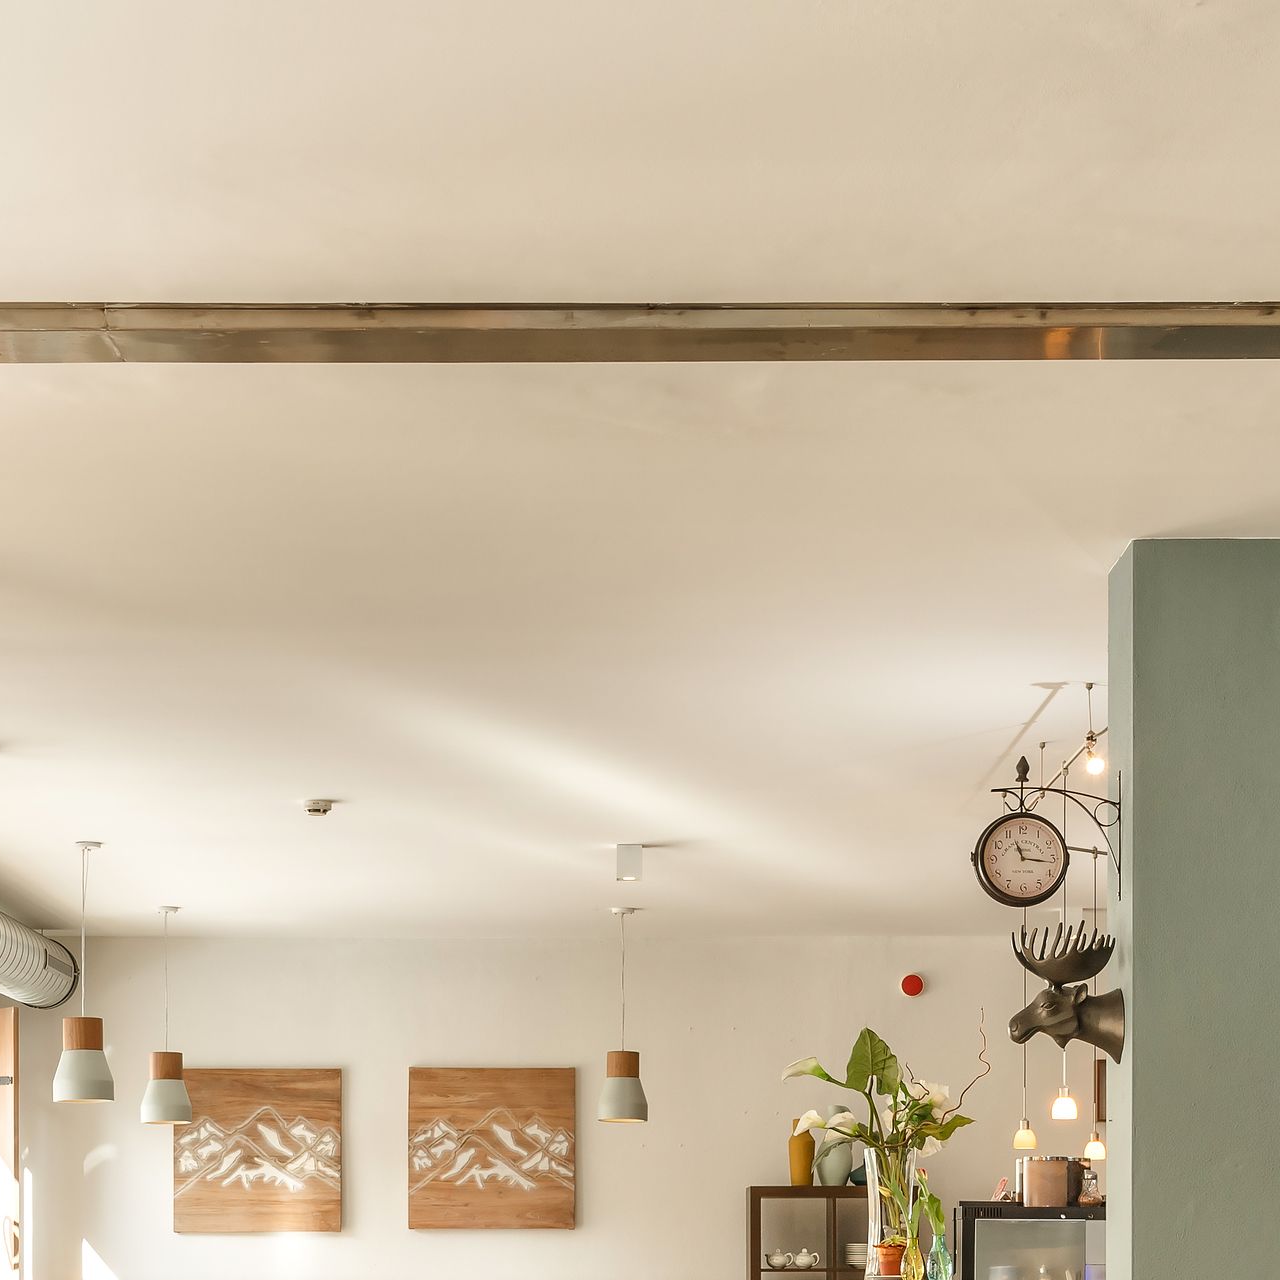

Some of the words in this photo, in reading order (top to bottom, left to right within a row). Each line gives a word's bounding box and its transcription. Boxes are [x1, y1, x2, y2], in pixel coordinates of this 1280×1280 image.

[1005, 830, 1012, 839] 11
[1018, 825, 1028, 835] 12
[994, 840, 1003, 850] 10
[1045, 839, 1052, 849] 2
[989, 854, 998, 864] 9
[1049, 854, 1056, 864] 3
[994, 869, 1002, 878] 8
[1045, 869, 1052, 878] 4
[1005, 879, 1012, 889] 7
[1019, 882, 1028, 892] 6
[1035, 879, 1043, 890] 5
